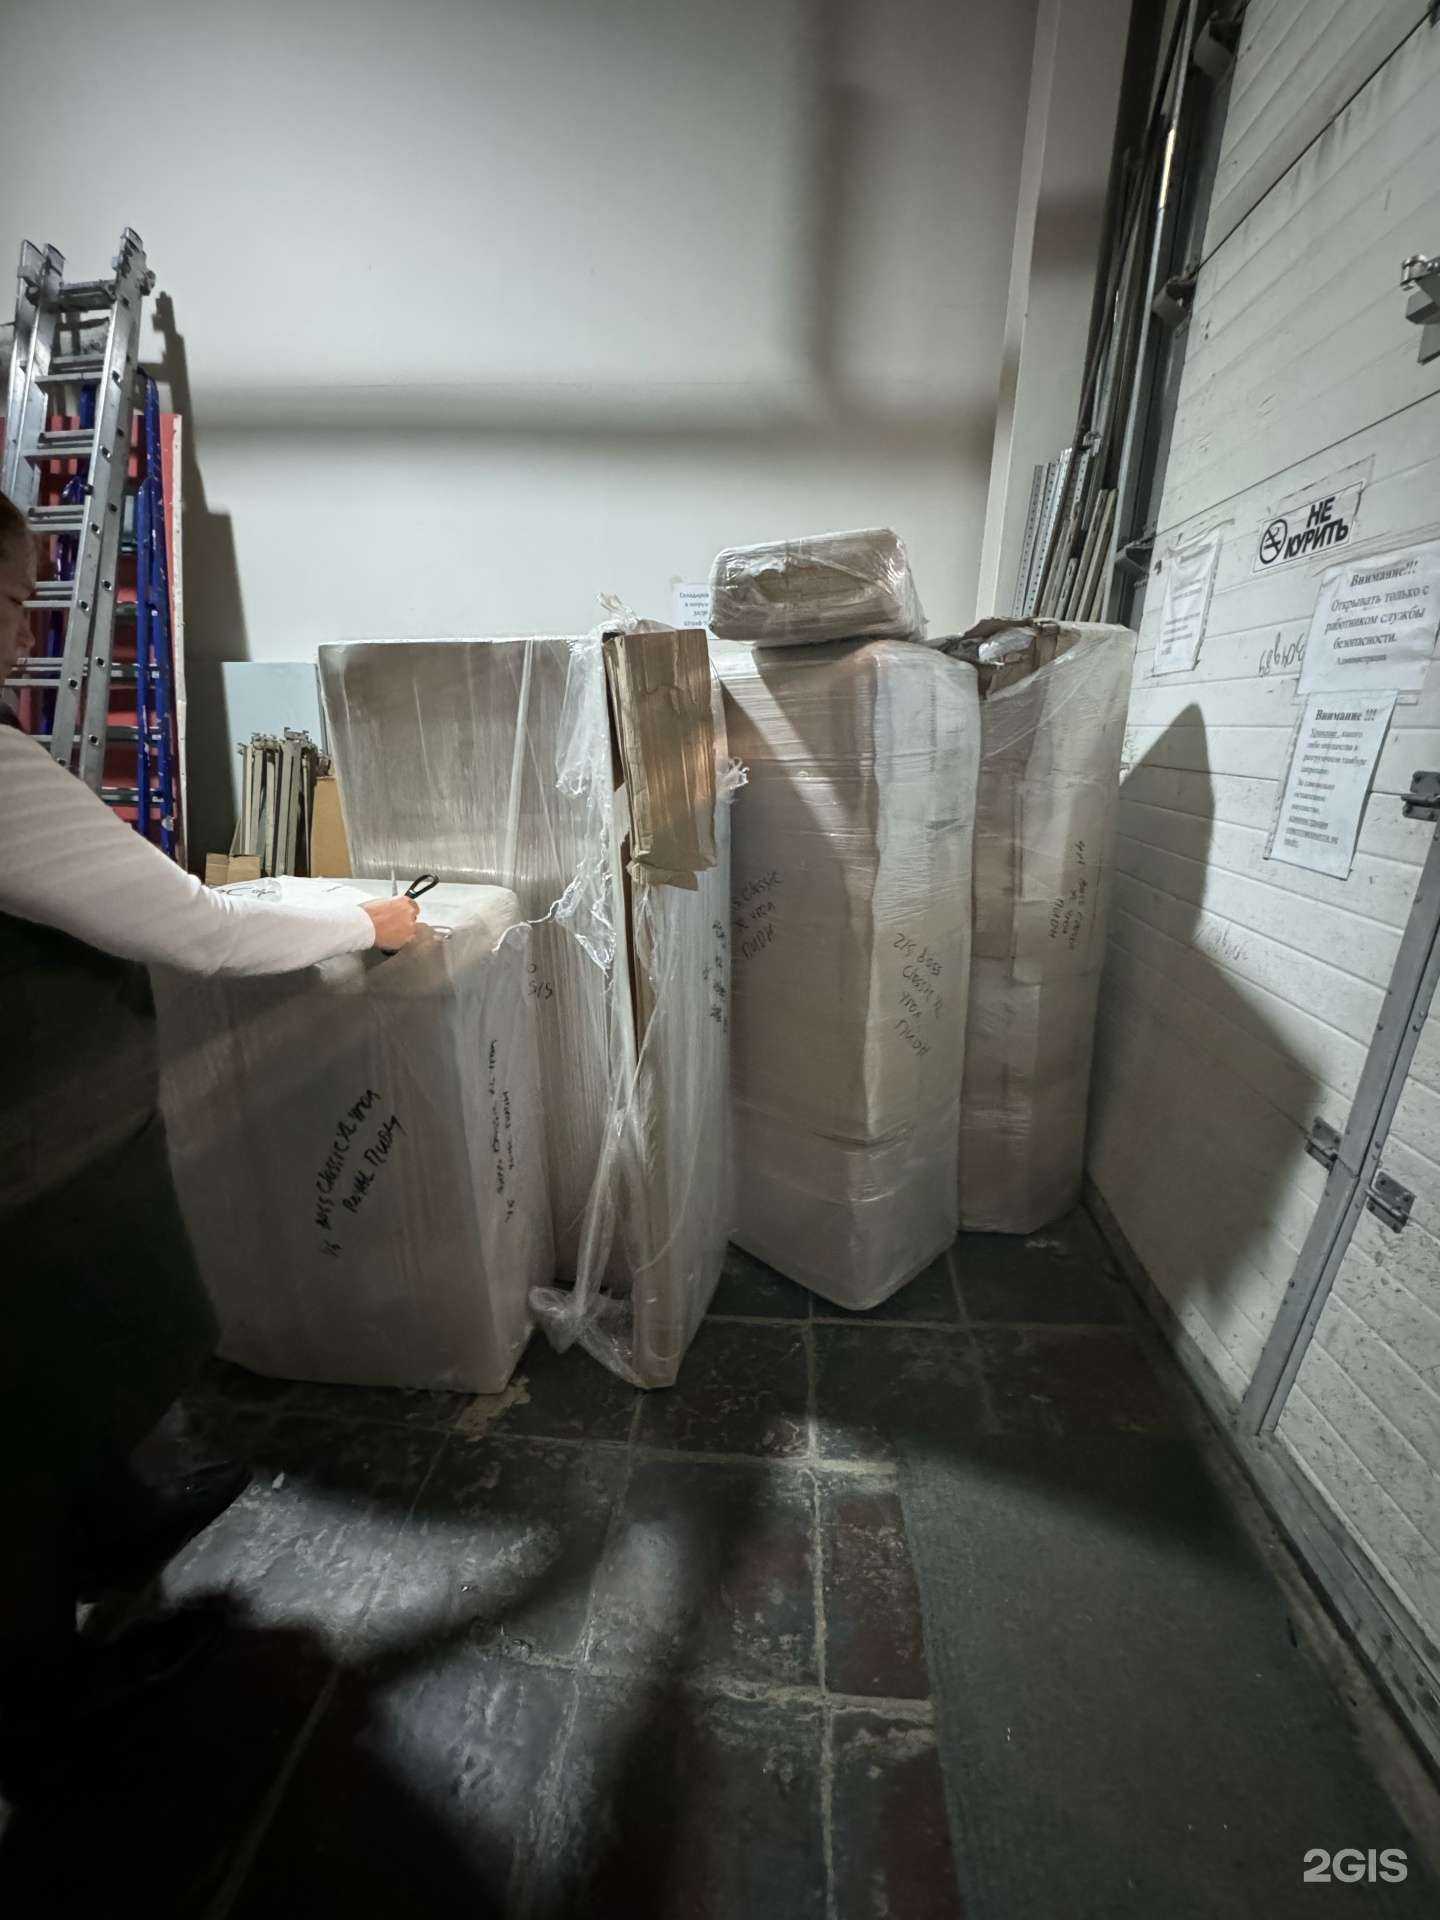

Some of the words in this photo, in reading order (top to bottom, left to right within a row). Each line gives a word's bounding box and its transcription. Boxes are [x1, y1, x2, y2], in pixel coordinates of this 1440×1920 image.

[1306, 496, 1336, 528] НЕ
[1283, 518, 1349, 559] КУРИТЬ
[1330, 595, 1381, 613] Открывать
[1385, 587, 1420, 603] только
[1325, 616, 1379, 635] работником
[1380, 605, 1426, 624] службы
[1315, 709, 1362, 721] Внимание
